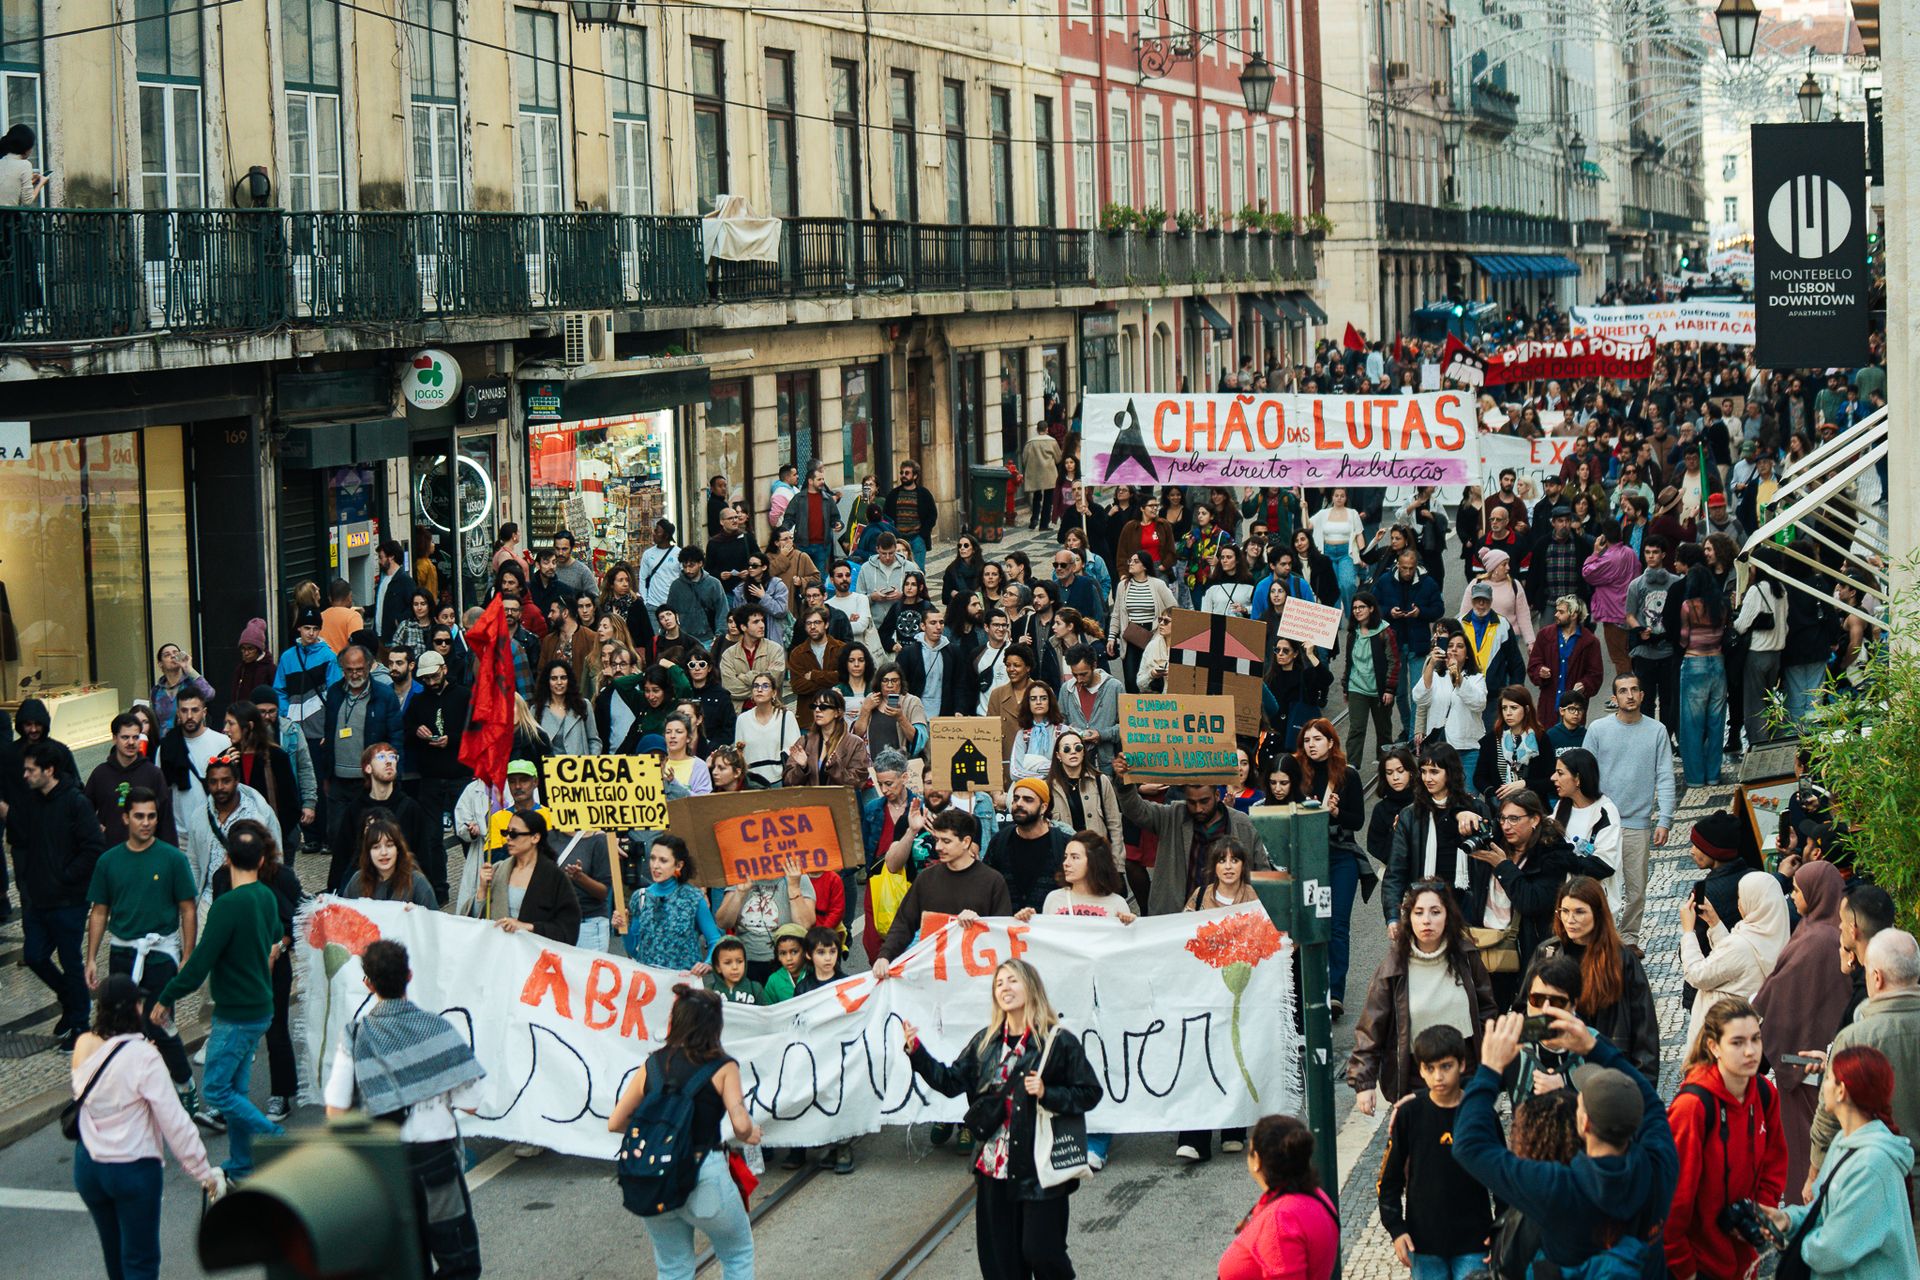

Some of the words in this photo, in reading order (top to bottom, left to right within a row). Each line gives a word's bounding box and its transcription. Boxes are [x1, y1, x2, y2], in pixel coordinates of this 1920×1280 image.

[1770, 268, 1852, 281] MONTEBELO
[1788, 282, 1835, 293] LISBON
[1769, 294, 1855, 307] DOWNTOWN
[1593, 312, 1645, 322] Queremos
[1681, 308, 1731, 319] Queremos
[1593, 323, 1650, 337] DIREITO
[1675, 320, 1755, 334] HABITAÇA
[1571, 341, 1585, 358] A
[1589, 337, 1652, 361] PORTA
[1501, 363, 1545, 380] casa
[1551, 359, 1597, 377] para
[414, 389, 444, 402] JOGOS
[478, 386, 507, 401] CANNABIS
[1153, 394, 1285, 453] CHÃO
[1287, 427, 1310, 443] DAS
[1313, 394, 1466, 452] LUTAS
[224, 430, 248, 444] 169
[1531, 440, 1577, 465] EX
[1168, 451, 1208, 482] pelo
[1221, 451, 1291, 478] direito
[1306, 460, 1323, 478] à
[1337, 452, 1448, 482] habitação
[466, 499, 485, 512] LISBOA
[350, 532, 368, 546] ATM
[932, 723, 963, 734] Casa
[635, 785, 656, 802] OU
[557, 806, 579, 826] UM
[589, 803, 667, 825] DIREITO?
[740, 814, 813, 843] CASA
[764, 838, 774, 853] É
[777, 838, 797, 851] UM
